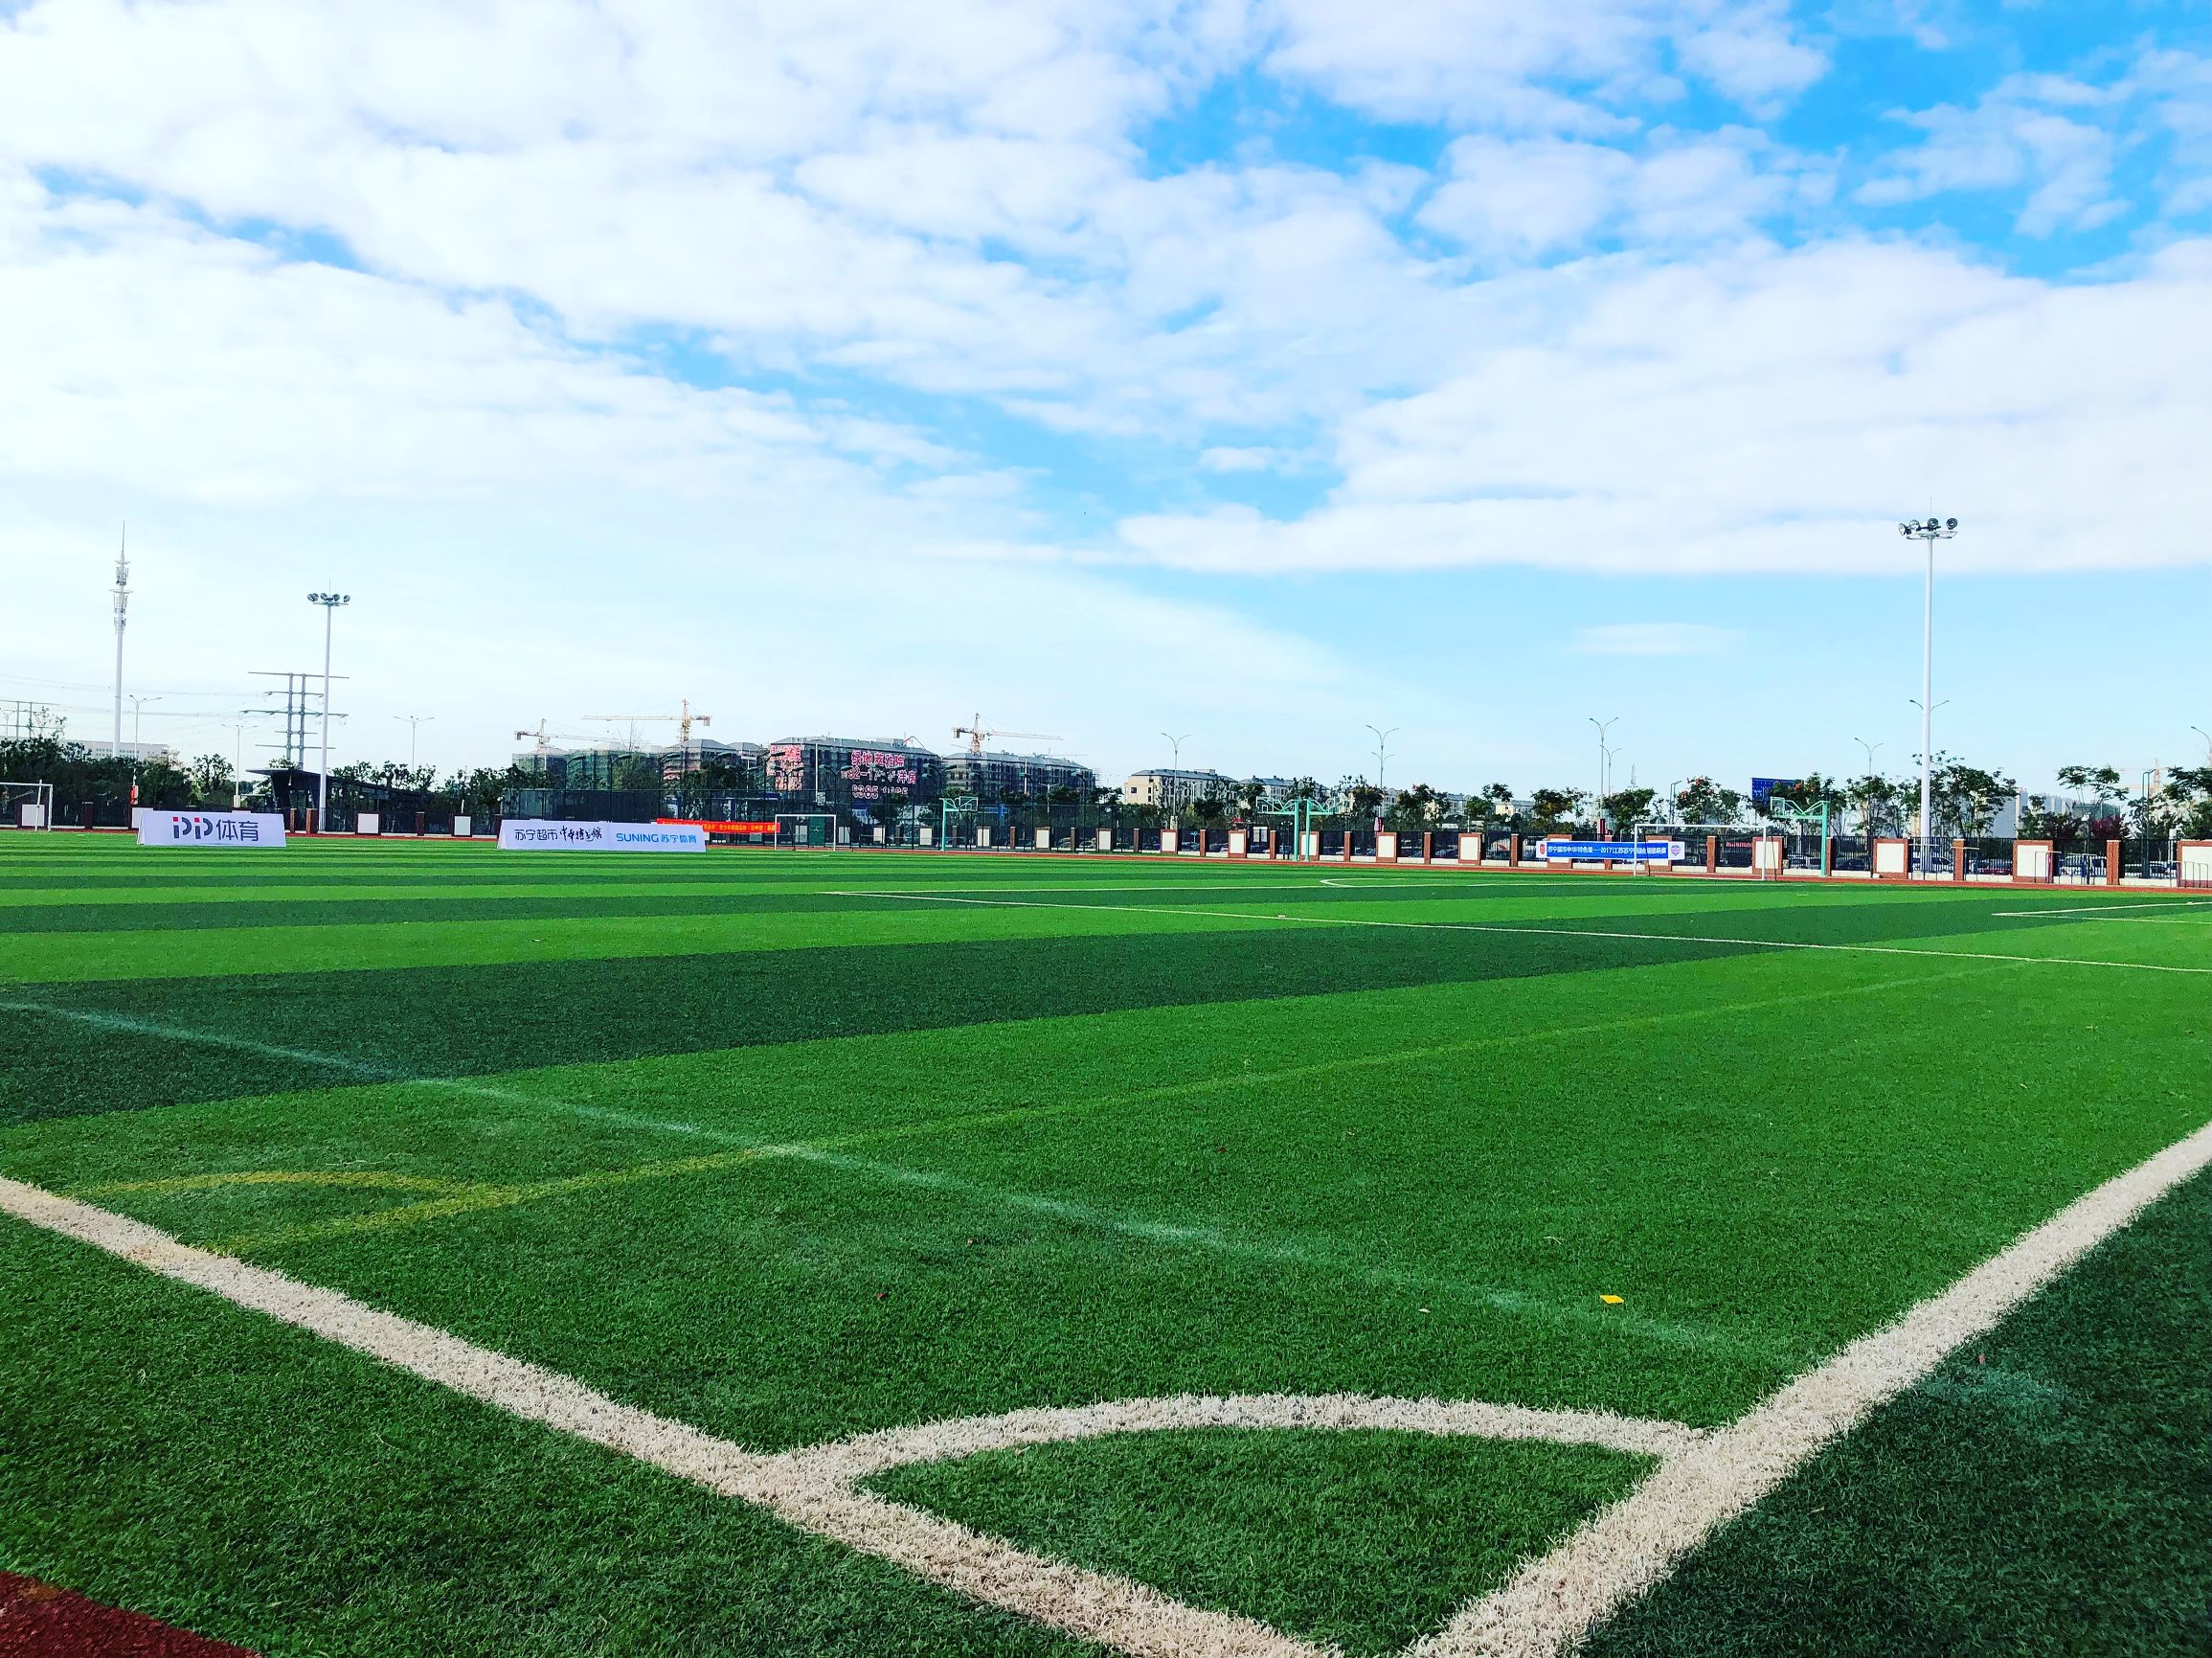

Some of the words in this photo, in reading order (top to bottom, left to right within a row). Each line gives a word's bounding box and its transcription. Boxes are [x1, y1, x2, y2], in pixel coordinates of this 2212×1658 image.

[514, 829, 558, 841] 苏宁超市
[616, 832, 659, 843] SUNING
[661, 833, 697, 844] 苏宁体育
